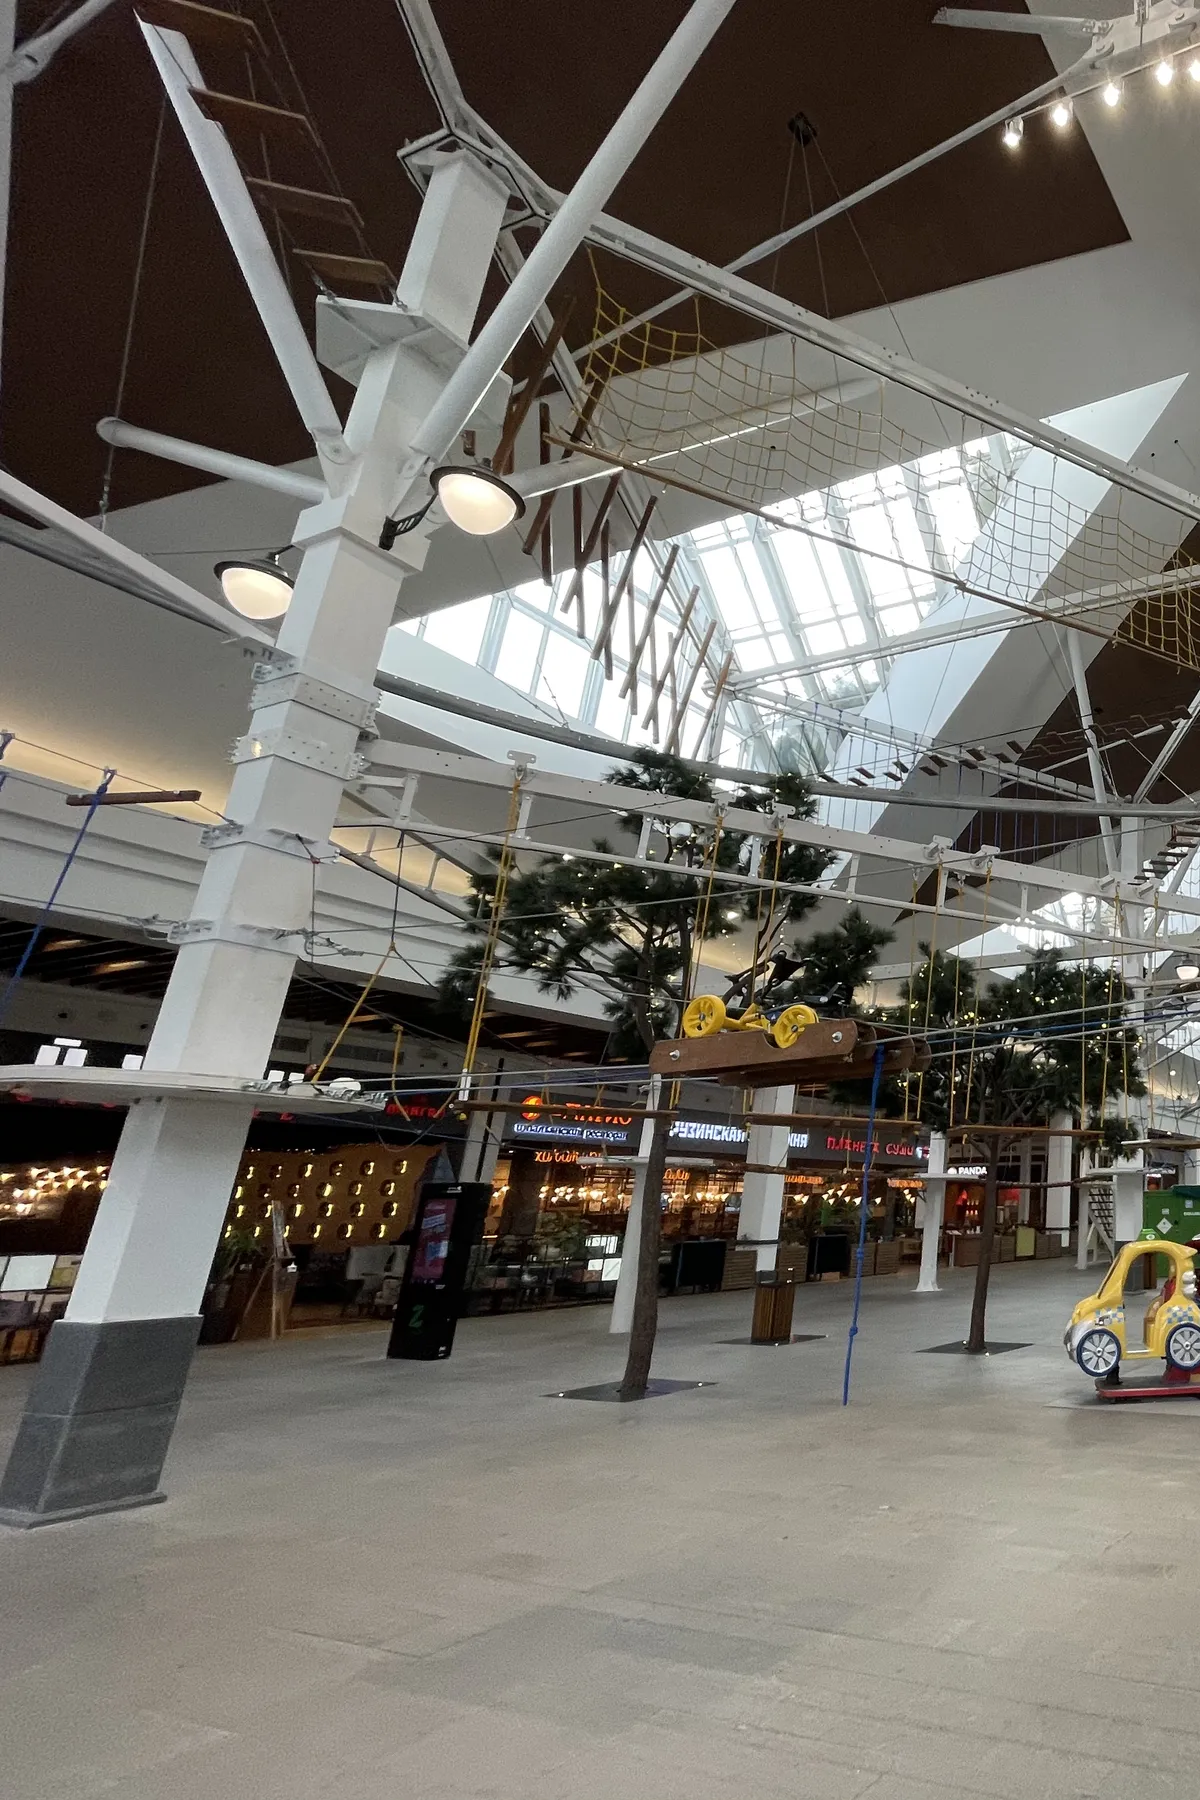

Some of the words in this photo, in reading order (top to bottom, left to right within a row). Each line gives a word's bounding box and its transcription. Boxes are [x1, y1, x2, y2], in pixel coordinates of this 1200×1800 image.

[669, 1120, 746, 1143] РУЗИНСКАЯ
[787, 1133, 808, 1148] ХНЯ
[826, 1136, 880, 1154] ПЛАНЕА
[885, 1142, 914, 1156] СУШИ
[958, 1166, 988, 1175] PANDA
